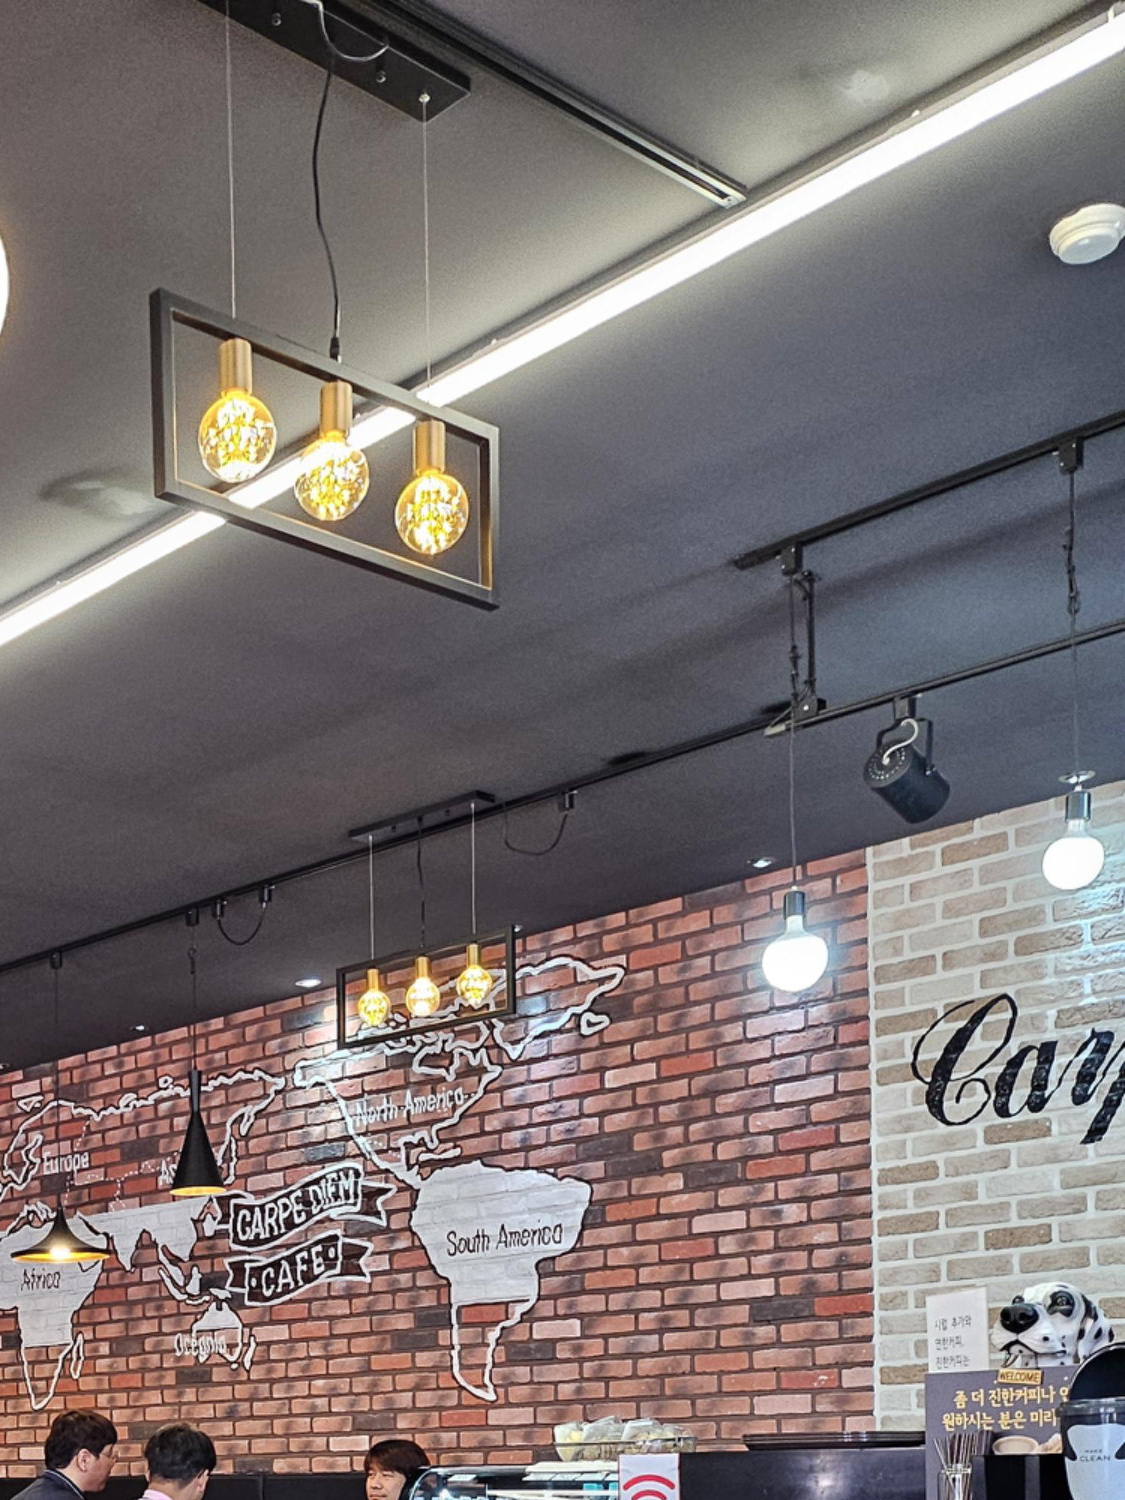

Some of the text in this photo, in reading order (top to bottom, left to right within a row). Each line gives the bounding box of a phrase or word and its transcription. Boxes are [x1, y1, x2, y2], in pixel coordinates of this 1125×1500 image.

[355, 1087, 464, 1126] North America
[42, 1152, 90, 1177] Europe
[237, 1169, 356, 1241] CARPE DIEM
[446, 1219, 563, 1257] South America
[21, 1268, 62, 1291] Africa
[262, 1245, 325, 1297] CAFE
[999, 1370, 1040, 1383] WELCOME
[953, 1390, 968, 1409] 좀
[971, 1389, 985, 1407] 더
[988, 1385, 1056, 1408] 진한커피나
[942, 1407, 1057, 1432] 원하시는 분은 미리
[1079, 1454, 1111, 1462] CLEAN
